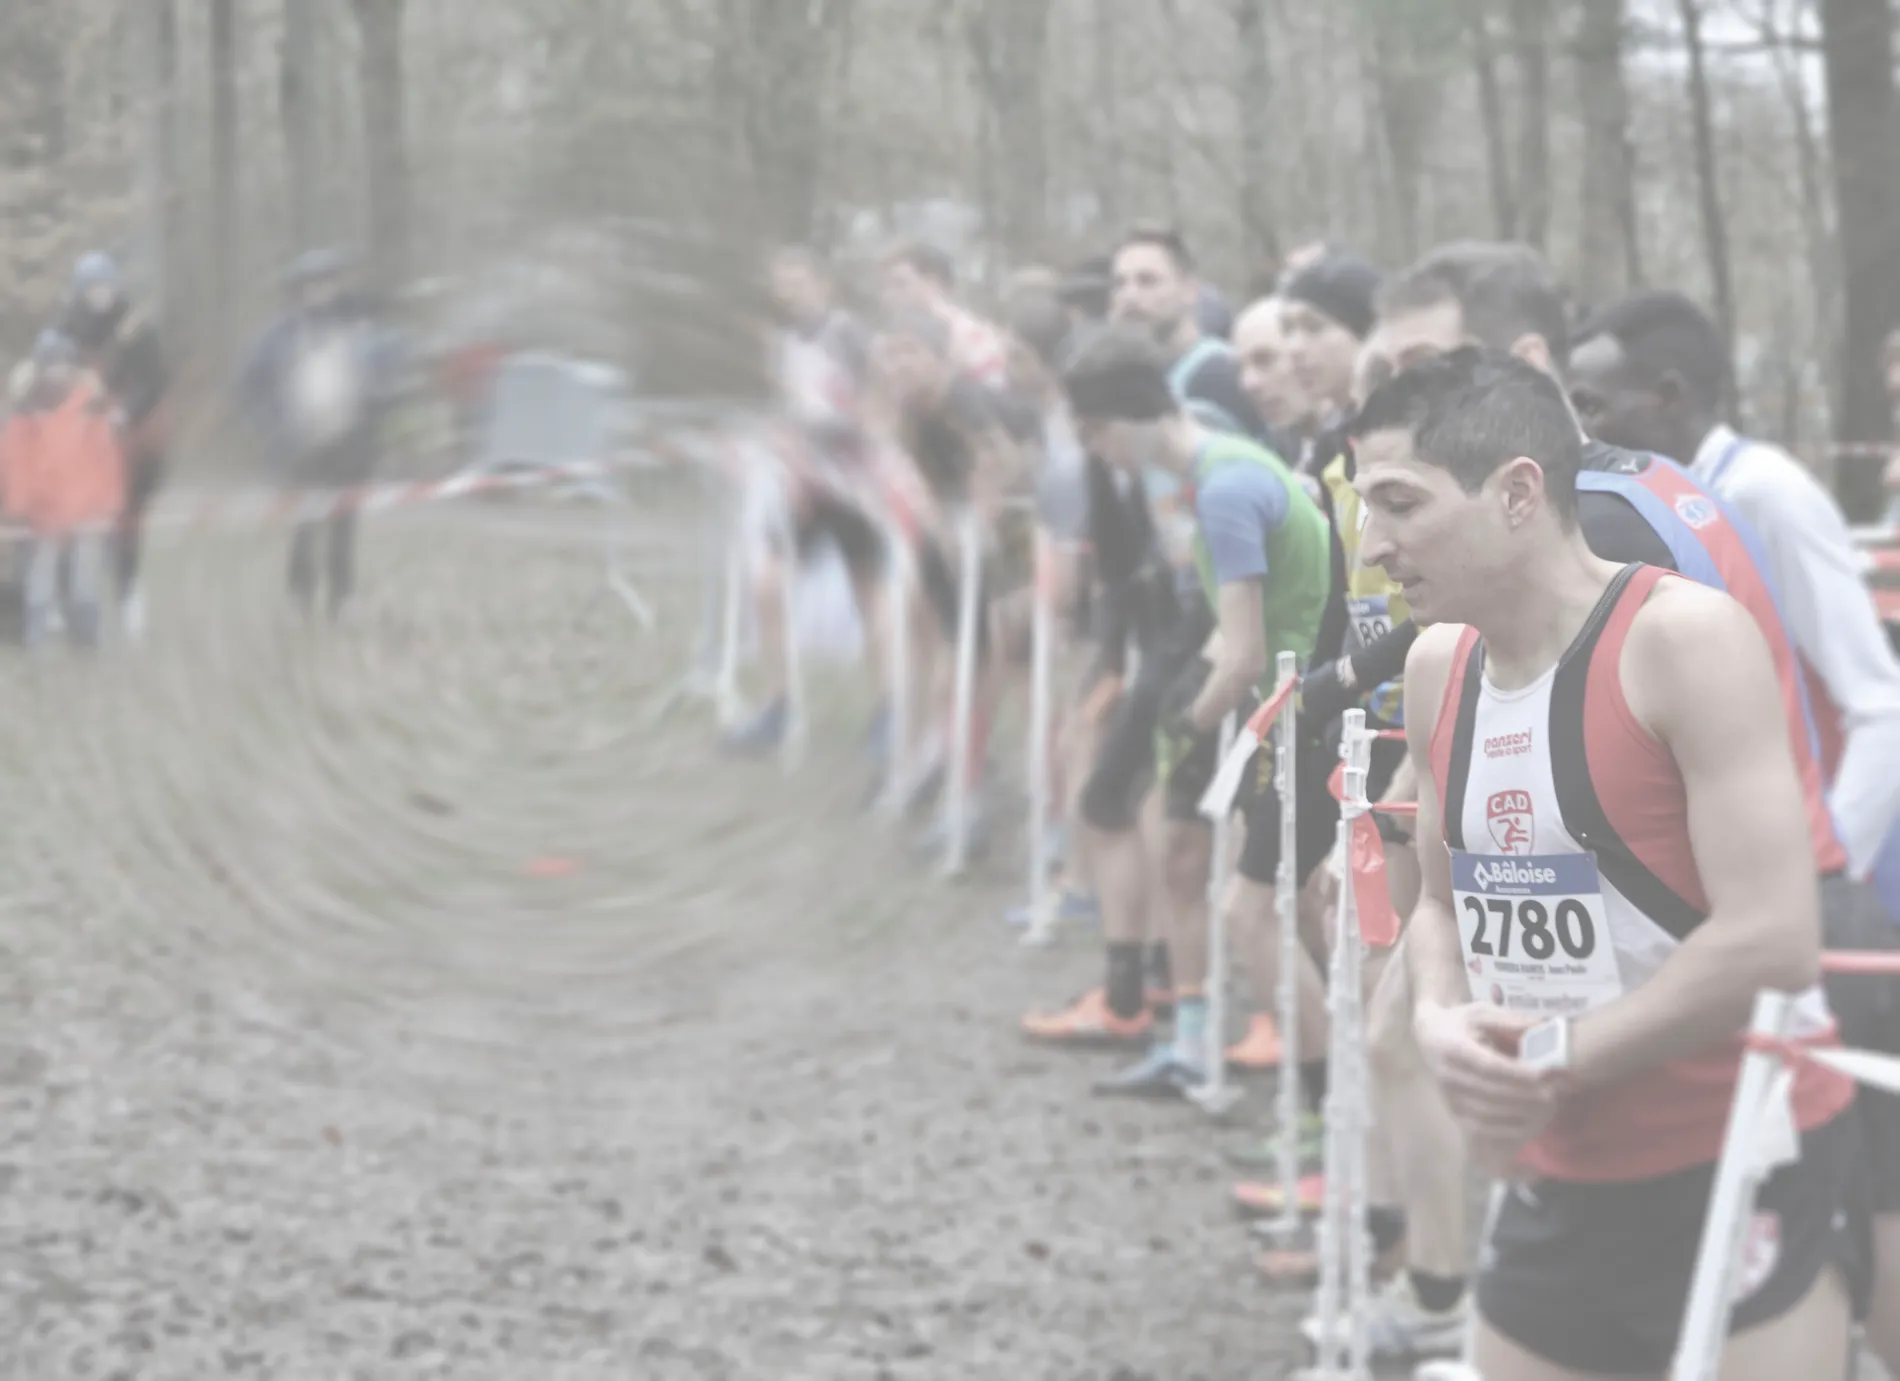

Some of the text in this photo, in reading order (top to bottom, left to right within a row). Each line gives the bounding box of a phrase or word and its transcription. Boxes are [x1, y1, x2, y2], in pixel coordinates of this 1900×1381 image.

[1484, 727, 1533, 754] panzeri
[1490, 794, 1528, 813] CAD
[1491, 860, 1557, 884] Bâloise
[1463, 896, 1596, 960] 2780
